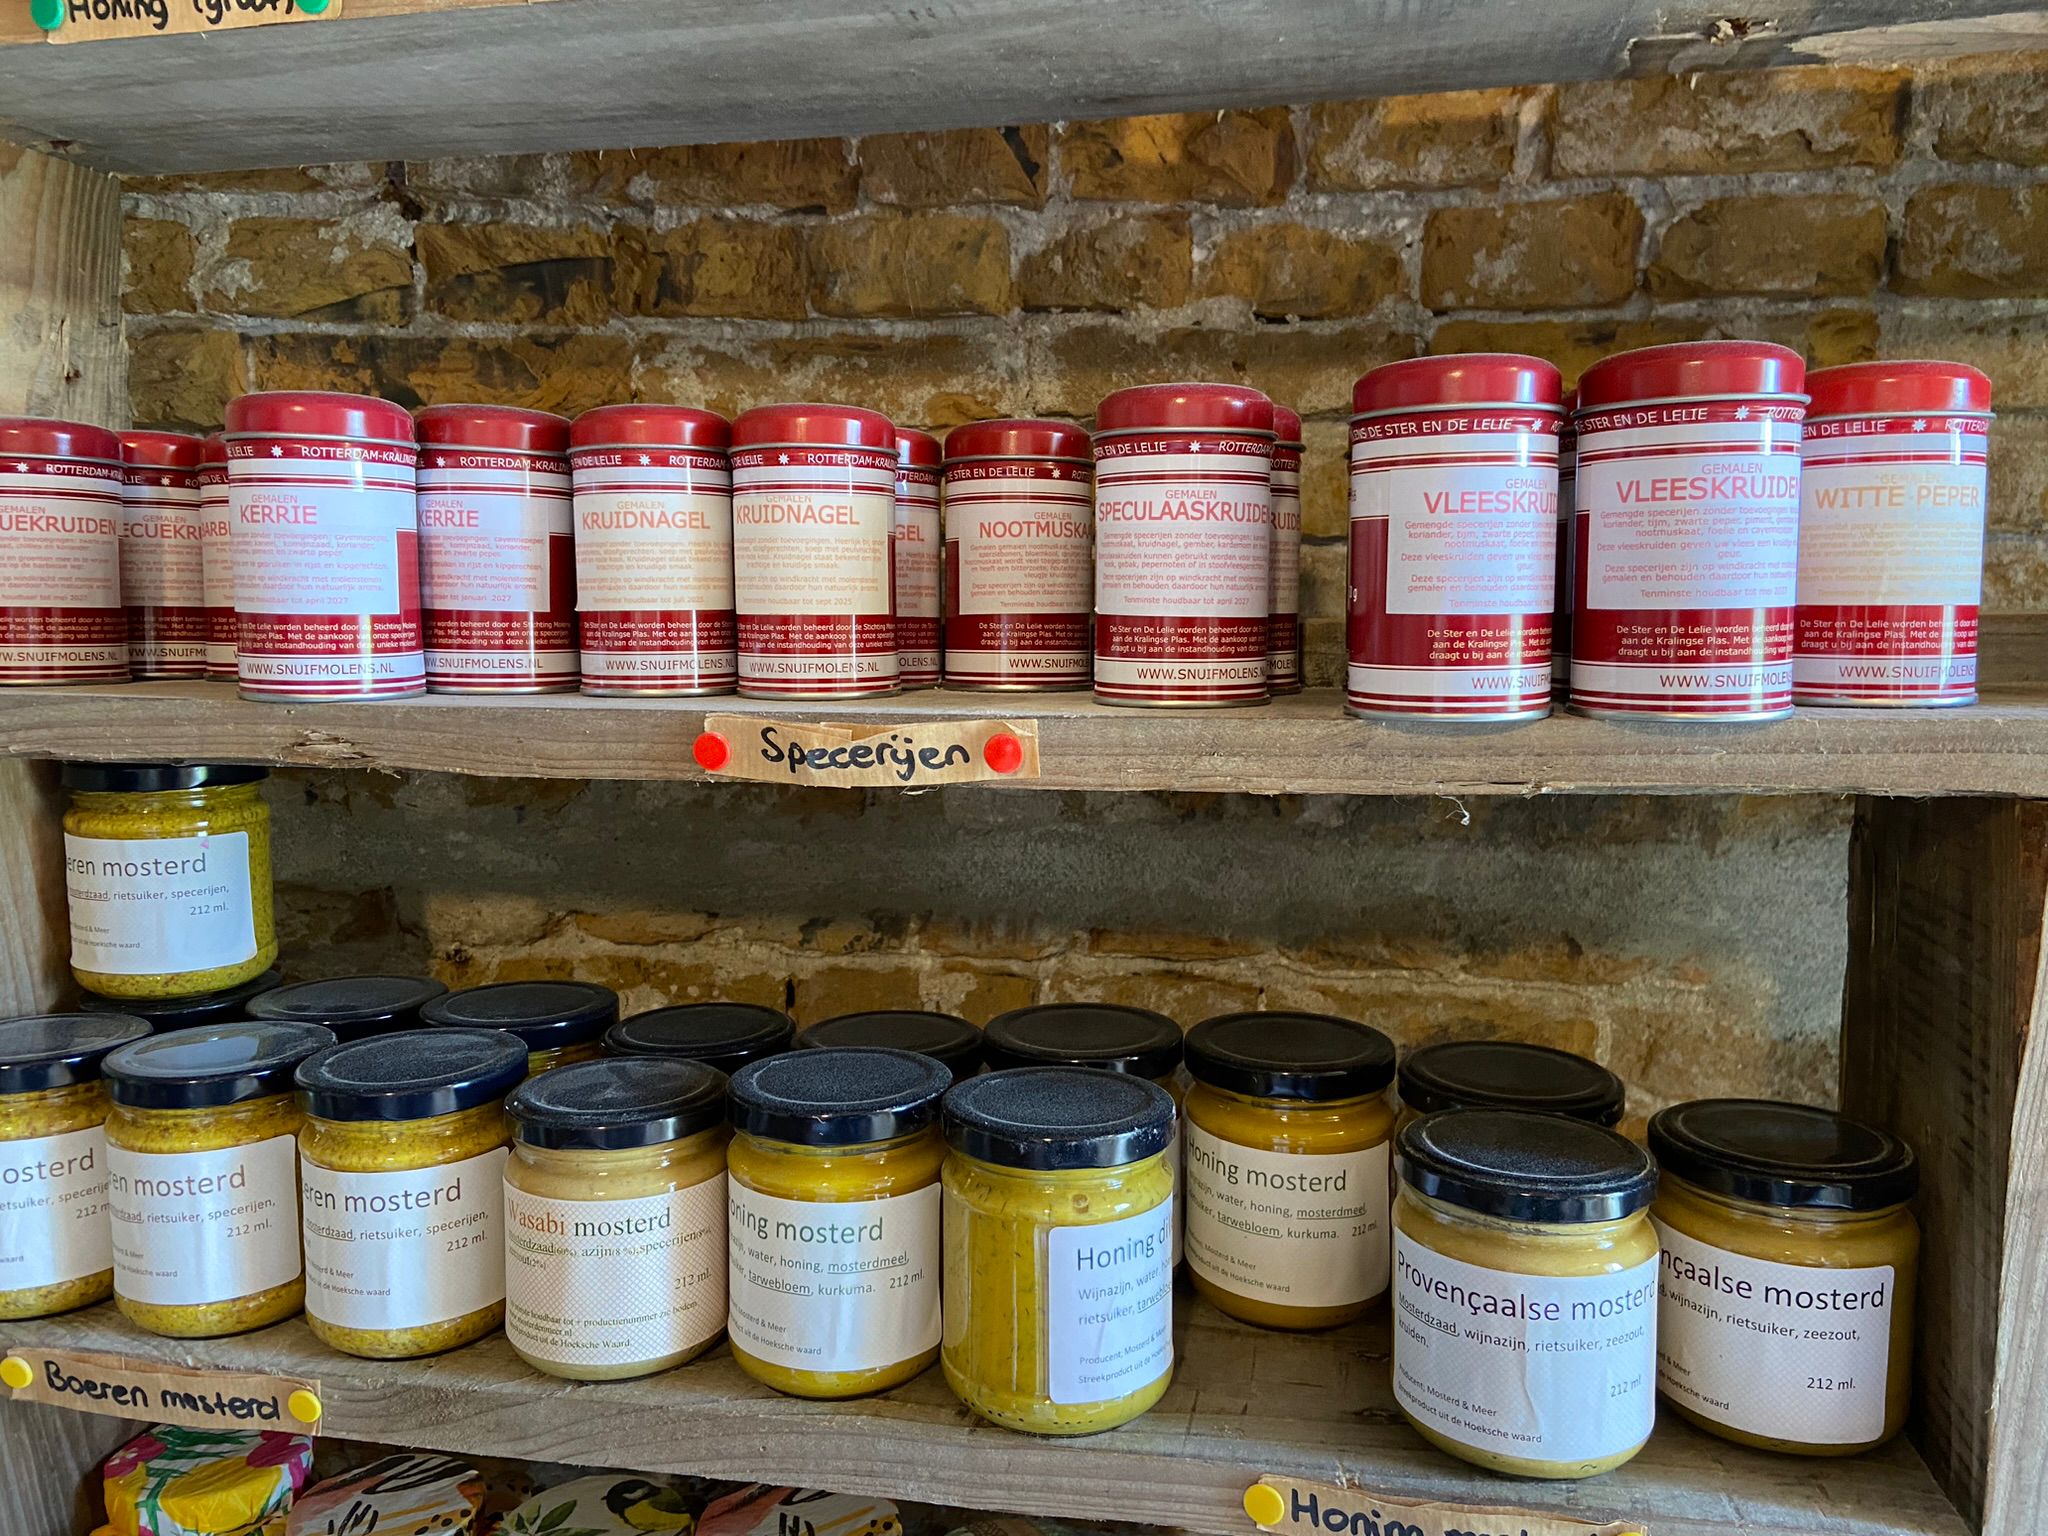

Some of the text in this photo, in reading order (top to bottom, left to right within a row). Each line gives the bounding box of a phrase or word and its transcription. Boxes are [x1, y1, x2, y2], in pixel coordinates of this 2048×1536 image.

[1585, 408, 1708, 429] STER EN DE LELIE
[1369, 418, 1512, 437] DE STER EN DE LELIE
[1822, 422, 1885, 434] DE LELIE
[1105, 445, 1116, 454] EN
[1119, 444, 1131, 454] DE
[1135, 442, 1167, 453] LELIE
[596, 455, 622, 465] LELIE
[954, 467, 1035, 479] STER EN DE LELIE
[1702, 463, 1762, 474] GEMALEN
[251, 494, 297, 504] GEMALEN
[1165, 490, 1217, 499] GEMALEN
[1815, 485, 1979, 509] WITTE PEPER
[426, 500, 463, 509] GEMALEN
[617, 501, 665, 510] GEMALEN
[142, 515, 186, 524] GEMALEN
[240, 505, 317, 525] KERRIE
[582, 511, 710, 530] KRUIDNAGEL
[736, 504, 859, 525] KRUIDNAGEL
[1034, 512, 1072, 520] GEMALEN
[304, 623, 338, 631] beheerd
[460, 620, 489, 628] beheerd
[803, 623, 834, 631] beheerd
[1157, 625, 1237, 634] Lelie worden beheerd
[1632, 625, 1749, 634] Ster Lelie worden
[1867, 619, 1926, 628] Lelie worden
[318, 632, 353, 641] aankoop
[472, 629, 503, 637] aankoop
[1134, 635, 1169, 644] Kralingse
[1444, 630, 1463, 638] Ster
[1836, 630, 1881, 640] Kralingse
[275, 641, 336, 650] instandhouding
[777, 641, 831, 649] instandhouding
[1468, 640, 1508, 649] Kralingse
[1656, 636, 1749, 645] Kralingse Plas. Met
[1178, 645, 1235, 654] instandhouding
[1618, 648, 1674, 657] draagt bij
[246, 663, 394, 675] WWW.SNUIFMOLENS.NL
[760, 726, 970, 781] Specerijen
[103, 852, 206, 877] mosterd
[114, 889, 168, 901] rietsuiker,
[171, 885, 229, 900] specerijen,
[190, 903, 229, 916] 212 ml.
[3, 1147, 94, 1184] osterd
[1188, 1137, 1347, 1193] Honing mosterd
[134, 1165, 245, 1197] mosterd
[345, 1177, 461, 1213] mosterd
[76, 1204, 97, 1219] 212
[1216, 1191, 1293, 1218] water, honing,
[147, 1200, 275, 1224] rietsuiker, specerijen,
[508, 1198, 670, 1237] Wasabi mosterd
[226, 1225, 250, 1238] 212
[360, 1210, 489, 1240] rietsuiker, specerijen,
[776, 1216, 883, 1244] mosterd
[1217, 1211, 1366, 1239] tarwebloem, kurkuma. 212
[446, 1239, 468, 1252] 212
[1077, 1232, 1154, 1271] Honing
[748, 1249, 777, 1266] water,
[780, 1256, 824, 1273] honing,
[674, 1274, 694, 1290] 212
[748, 1270, 813, 1296] tarwebloem,
[818, 1283, 876, 1296] kurkuma.
[889, 1274, 909, 1289] 212
[1266, 1282, 1290, 1293] waard
[1398, 1250, 1560, 1321] Provençaalse
[1079, 1281, 1134, 1302] Wijnazijn,
[1765, 1282, 1884, 1310] mosterd
[1079, 1305, 1135, 1325] rietsuiker,
[1669, 1290, 1860, 1341] wijnazijn, rietsuiker, zeezout,
[768, 1319, 786, 1333] Meer
[602, 1338, 630, 1348] Waard
[1464, 1328, 1602, 1353] wijnazijn, rietsuiker,
[797, 1345, 822, 1355] waard
[1079, 1365, 1133, 1384] Streekproduct
[44, 1360, 281, 1421] Boeren mosterd
[1610, 1380, 1629, 1398] 212
[1807, 1377, 1856, 1390] 212 ml.
[1427, 1384, 1497, 1417] Mosterd & Meer
[1702, 1395, 1729, 1410] waard
[1451, 1414, 1542, 1444] de Hoeksche waard
